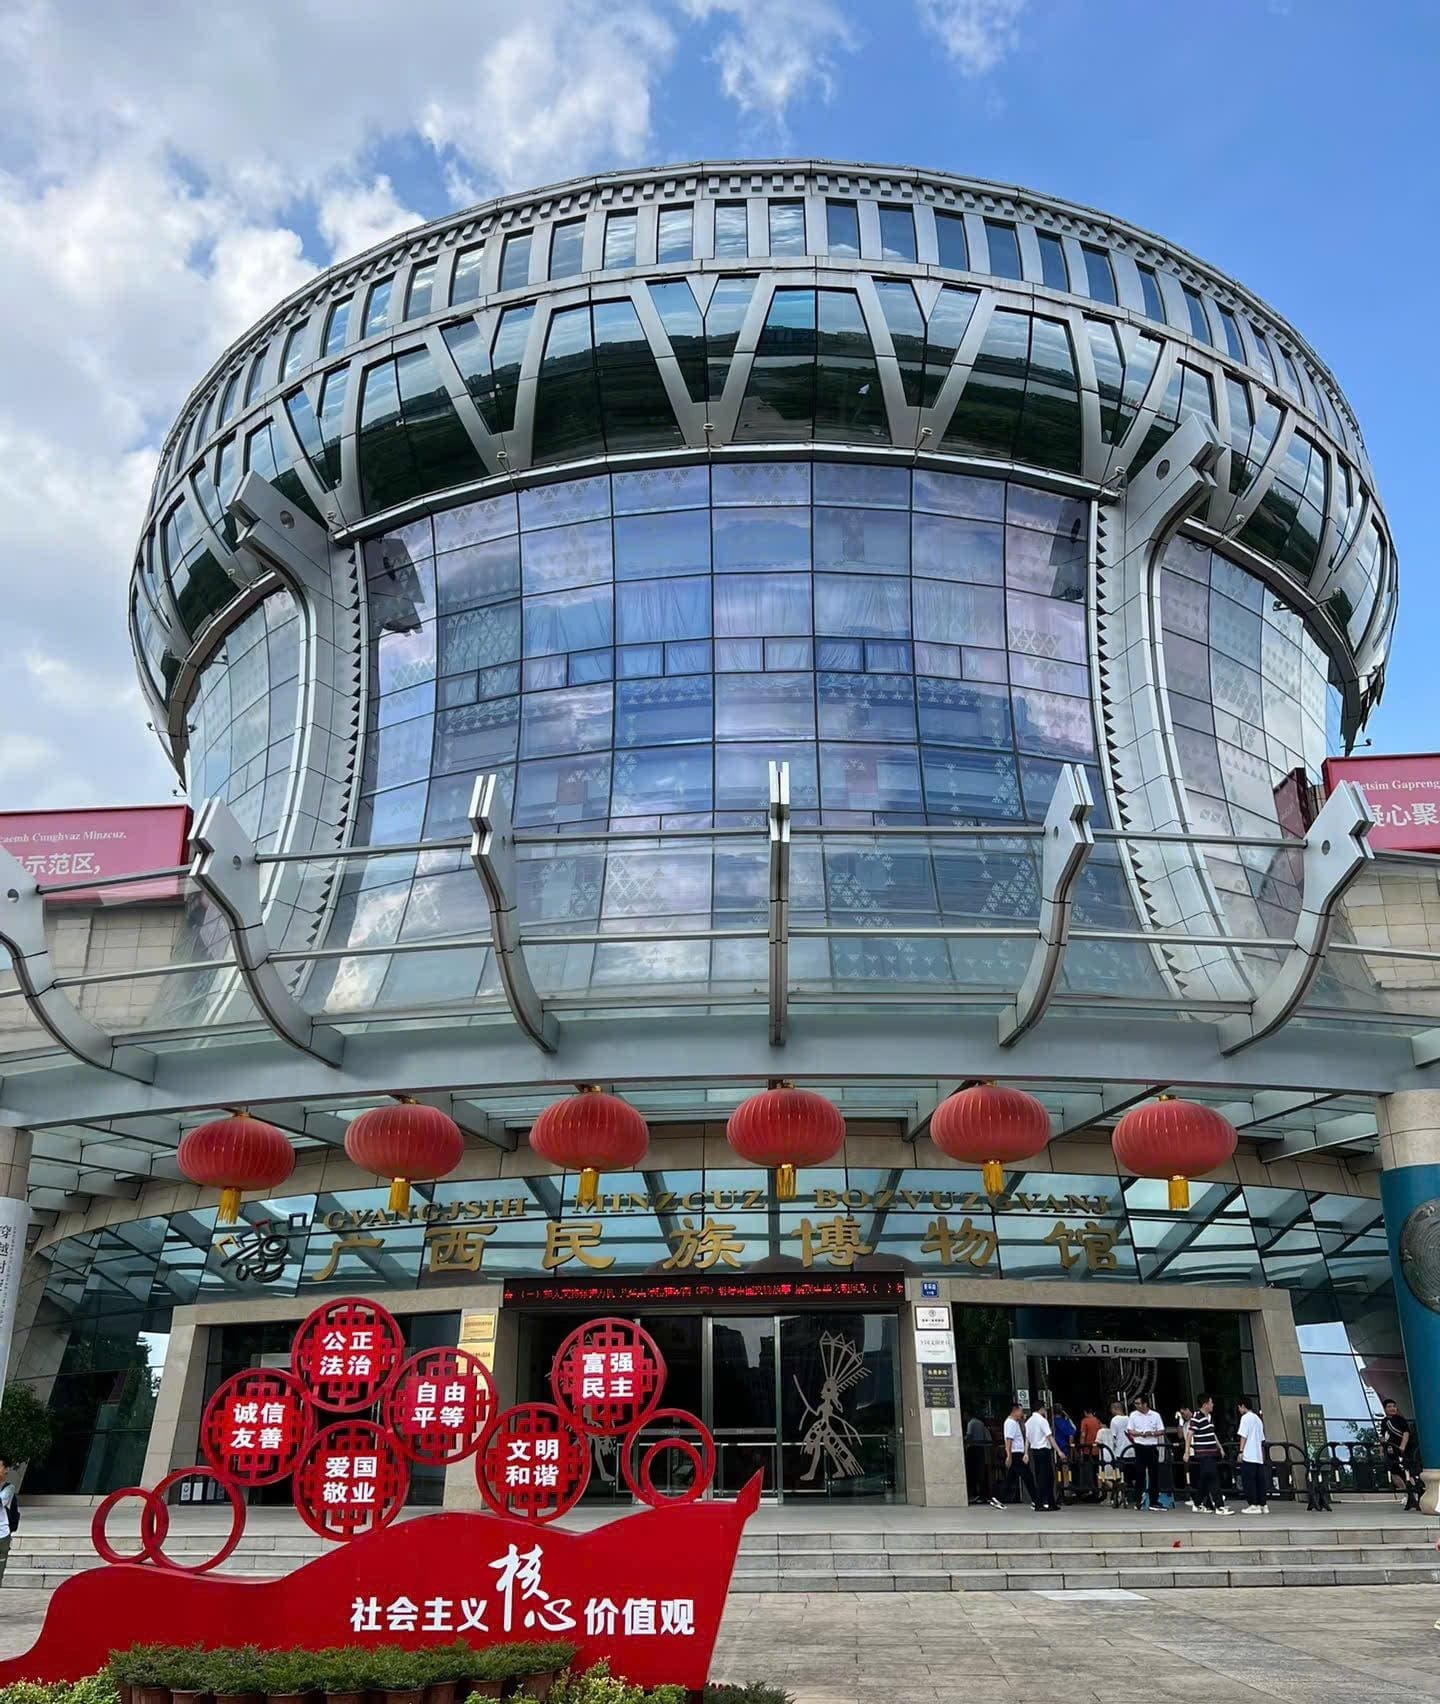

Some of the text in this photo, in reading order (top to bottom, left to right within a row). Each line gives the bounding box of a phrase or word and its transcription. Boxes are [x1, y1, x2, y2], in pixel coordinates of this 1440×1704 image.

[1360, 781, 1389, 791] etsim
[323, 1197, 529, 1230] GVANGJSIH
[571, 1189, 767, 1214] MINZCUZ
[311, 1215, 1120, 1281] 广西民族博物馆
[322, 1331, 374, 1352] 公正
[319, 1353, 373, 1377] 法治
[582, 1352, 635, 1374] 富强
[416, 1381, 466, 1404] 自由
[581, 1376, 635, 1399] 民主
[233, 1402, 284, 1424] 诚信
[411, 1406, 466, 1428] 平等
[230, 1425, 284, 1449] 友善
[506, 1439, 559, 1463] 文明
[325, 1455, 378, 1479] 爱国
[504, 1463, 560, 1488] 和谐
[322, 1479, 377, 1504] 敬业
